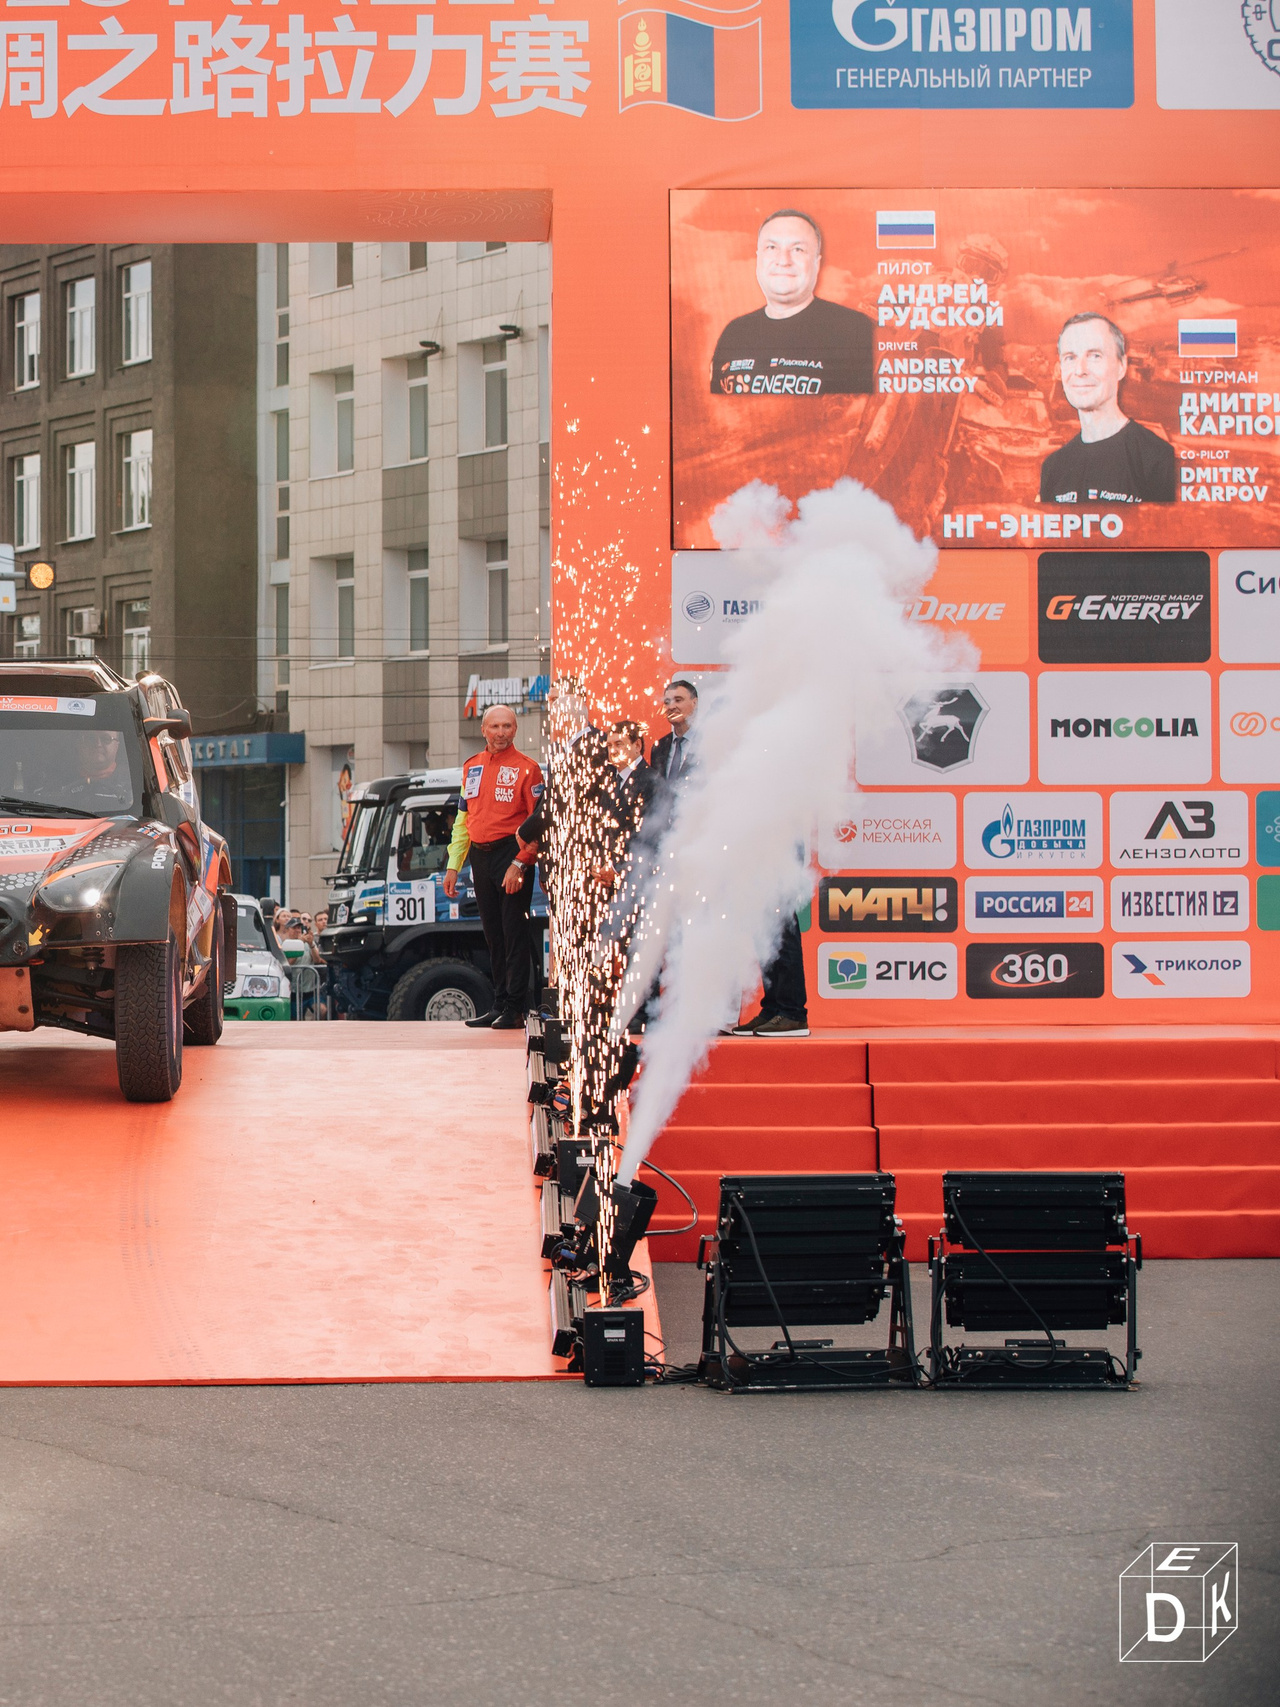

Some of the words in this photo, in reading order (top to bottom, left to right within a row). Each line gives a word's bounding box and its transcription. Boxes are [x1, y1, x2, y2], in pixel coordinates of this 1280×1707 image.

[911, 8, 1092, 53] ГАЗПРОМ
[836, 64, 991, 89] ГЕНЕРАЛЬНЫЙ
[999, 67, 1092, 89] ПАРТНЕР
[877, 262, 932, 275] ПИЛОТ
[877, 278, 988, 307] АНДРЕЙ
[878, 301, 1004, 330] РУДСКОЙ
[878, 341, 918, 351] DRIVER
[878, 358, 965, 375] ANDREY
[751, 374, 822, 395] ENERGO
[878, 376, 979, 394] RUDSKOY
[1179, 371, 1259, 384] ШТУРМАН
[1180, 450, 1231, 460] CO-PILOT
[1180, 467, 1260, 484] DMITRY
[1180, 485, 1269, 502] KARPOV
[943, 513, 1125, 539] НГ-ЭНЕРГО
[1110, 594, 1167, 602] МОТОРНОЕ
[1167, 594, 1204, 602] МАСЛО
[2, 703, 54, 711] MONGOLIA
[1050, 717, 1199, 739] MONGOLIA
[194, 739, 252, 760] КСТАТ
[494, 787, 514, 796] SILK
[494, 794, 514, 803] WAY
[862, 818, 932, 830] РУССКАЯ
[1016, 819, 1086, 838] ГАЗПРОМ
[862, 832, 942, 843] МЕХАНИКА
[1018, 840, 1086, 849] ДОБЫЧА
[395, 897, 426, 921] 301
[983, 896, 1057, 913] РОССИЯ
[1068, 896, 1091, 912] 24
[1121, 891, 1208, 917] ИЗВЕСТИЯ
[875, 960, 948, 981] 2ГИС
[1002, 953, 1069, 984] 360
[1155, 959, 1242, 971] ТРИКОЛОР
